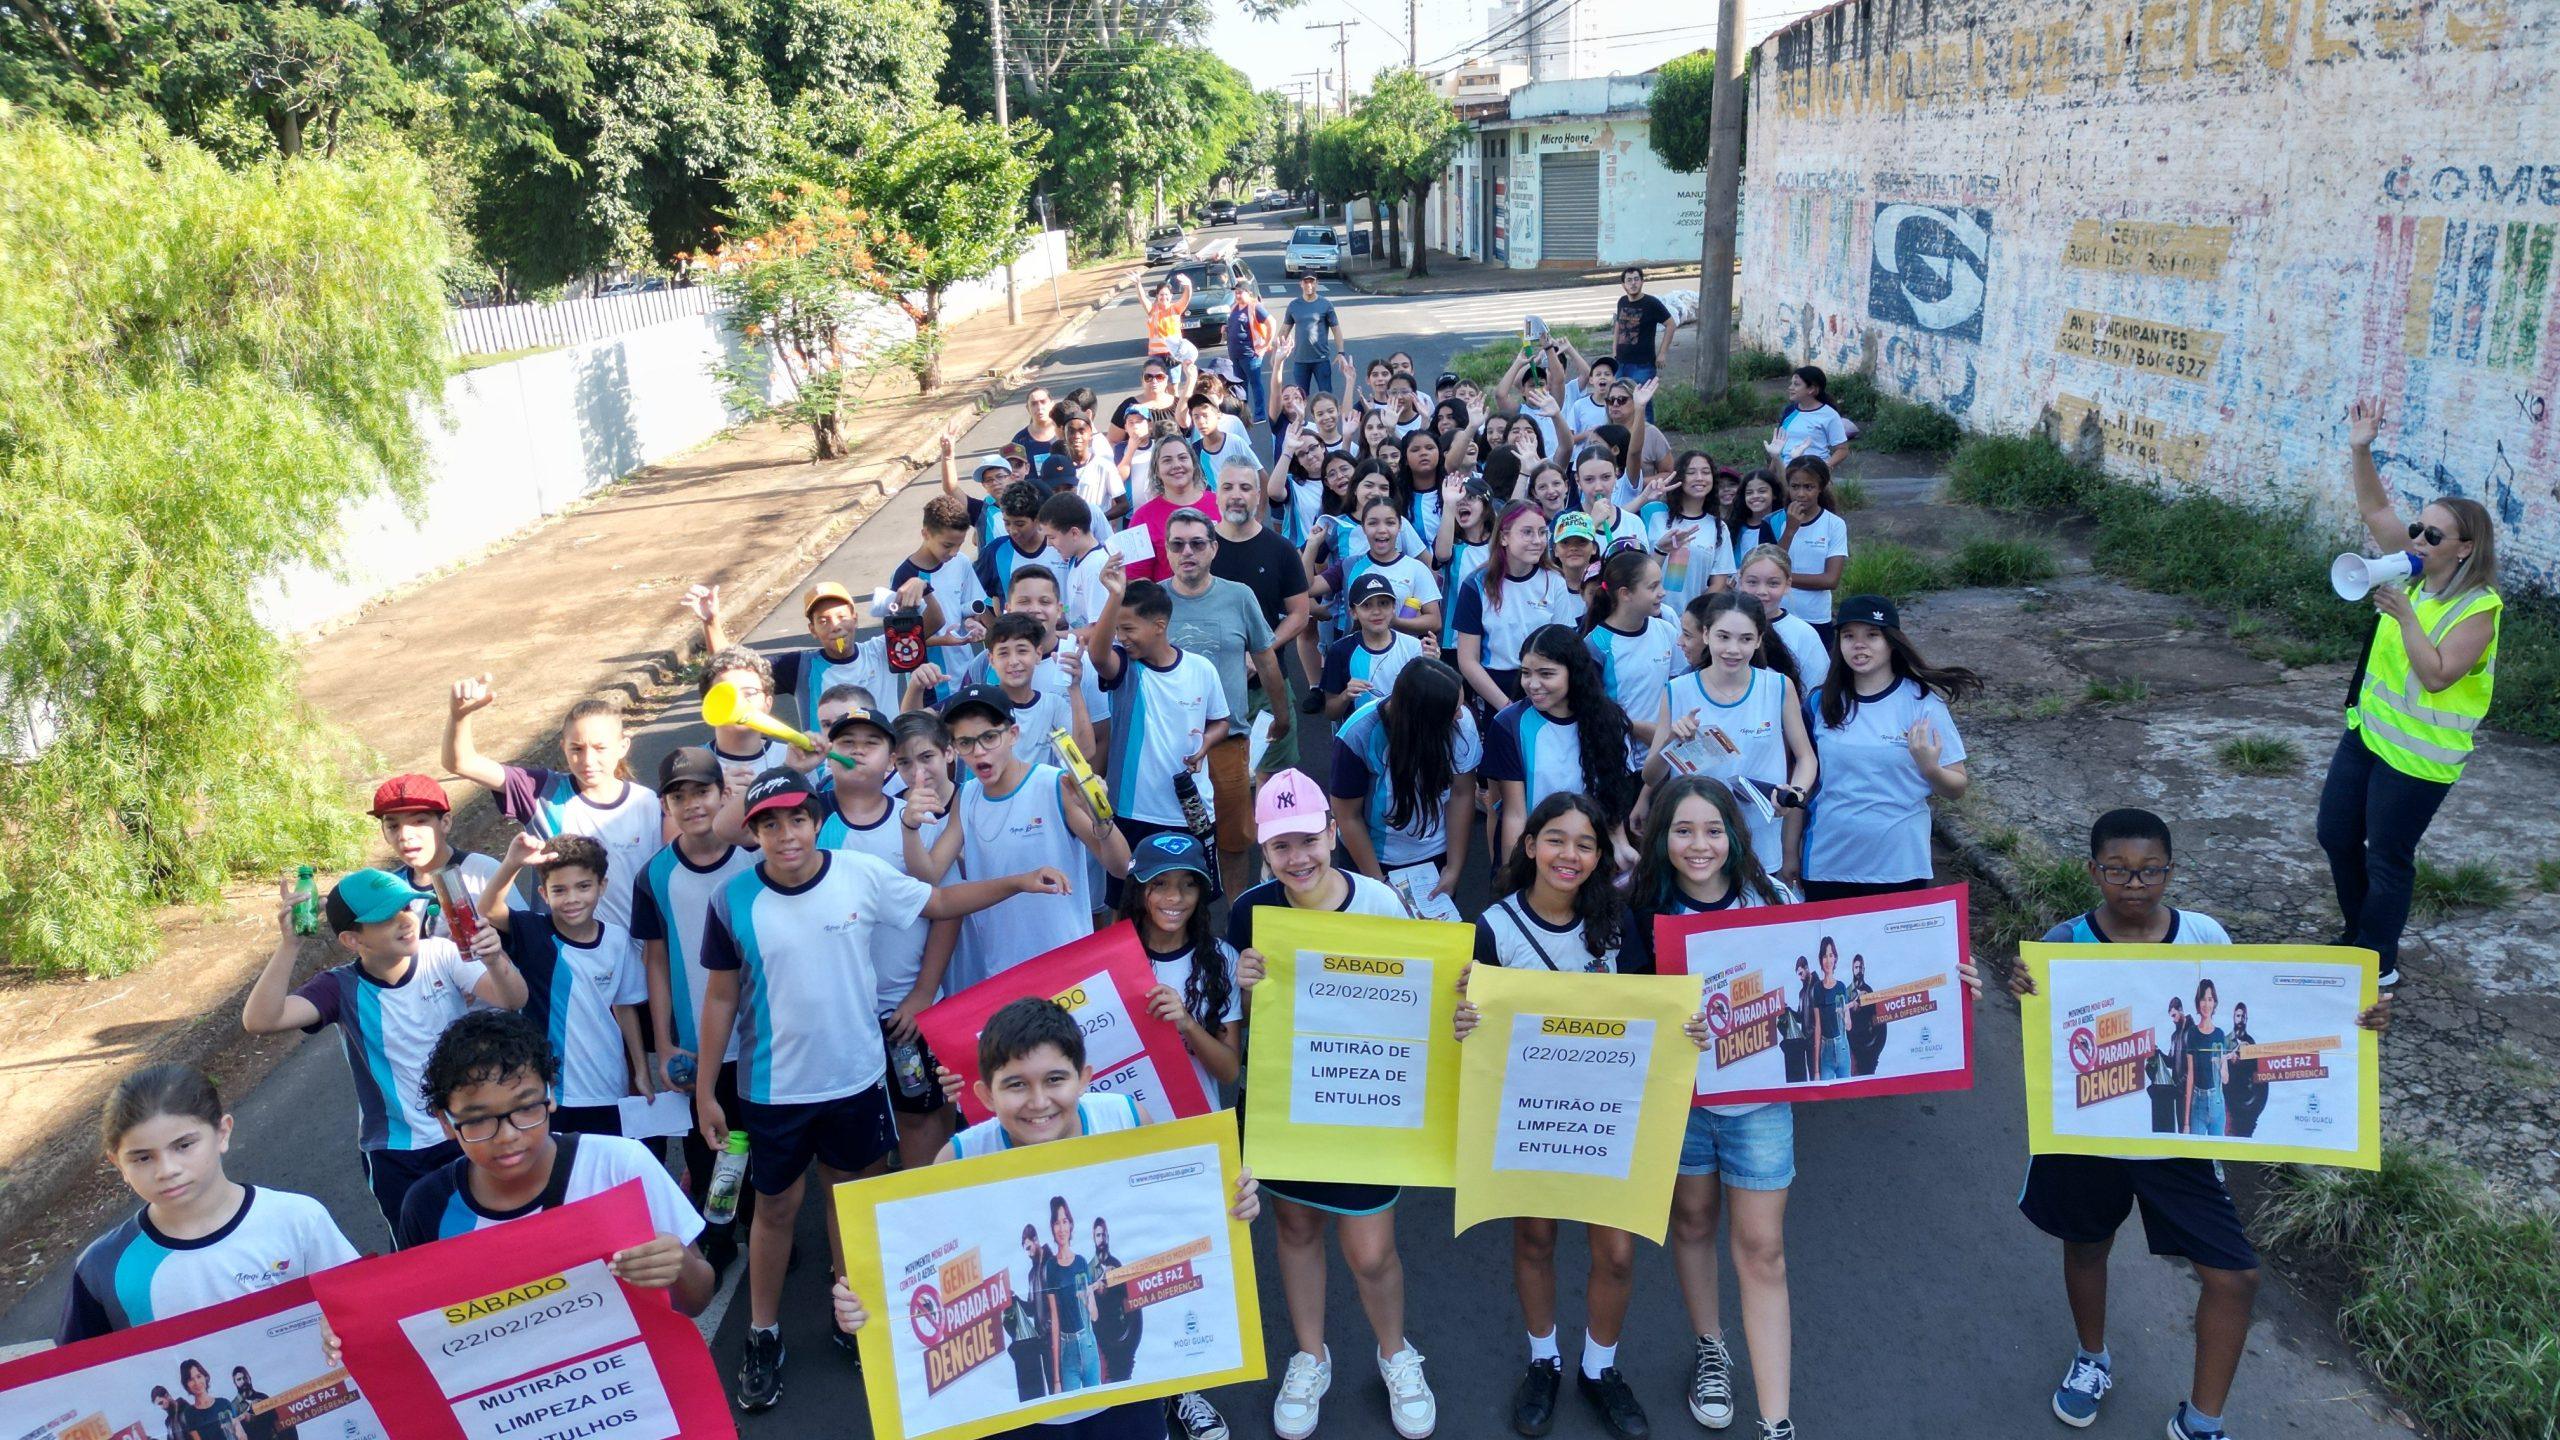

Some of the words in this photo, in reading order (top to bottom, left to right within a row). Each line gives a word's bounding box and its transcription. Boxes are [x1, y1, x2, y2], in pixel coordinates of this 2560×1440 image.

[1540, 133, 1563, 144] Micro
[2090, 318, 2188, 350] BNDEIRANTES
[1277, 791, 1295, 809] NY
[1324, 956, 1404, 975] SÁBADO
[1309, 982, 1418, 1006] (22/02/2025)
[1732, 976, 1761, 1000] GENTE
[1733, 1004, 1768, 1027] PARADA
[1769, 992, 1782, 1016] DÁ
[1885, 996, 1906, 1012] VOCÊ
[1907, 993, 1922, 1007] FAZ
[1542, 1017, 1626, 1036] SÁBADO
[2099, 1017, 2129, 1040] GENTE
[1310, 1040, 1384, 1056] MUTIRÃO
[1389, 1046, 1410, 1058] DE
[1720, 1020, 1770, 1065] DENGUE
[2099, 1043, 2135, 1066] PARADA
[2137, 1028, 2152, 1058] DÁ
[1522, 1046, 1637, 1067] (22/02/2025)
[2267, 1056, 2292, 1070] VOCÊ
[2294, 1055, 2311, 1067] FAZ
[1115, 1066, 1138, 1084] DE
[1312, 1066, 1380, 1081] LIMPEZA
[1385, 1070, 1407, 1082] DE
[2081, 1062, 2137, 1103] DENGUE
[2257, 1072, 2276, 1082] TODA
[2285, 1067, 2326, 1080] DIFERENÇA!
[1315, 1091, 1401, 1106] ENTULHOS
[1518, 1097, 1595, 1112] MUTIRÃO
[1600, 1101, 1622, 1113] DE
[1517, 1120, 1588, 1134] LIMPEZA
[1594, 1123, 1616, 1135] DE
[1518, 1141, 1608, 1157] ENTULHOS
[942, 1255, 979, 1294] GENTE
[1137, 1271, 1164, 1292] VOCÊ
[1165, 1266, 1184, 1284] FAZ
[446, 1277, 567, 1325] SÁBADO
[946, 1293, 990, 1332] PARADA
[991, 1278, 1008, 1310] DÁ
[1128, 1295, 1149, 1309] TODA
[1150, 1292, 1156, 1301] A
[1157, 1279, 1201, 1300] DIFERENÇA!
[442, 1291, 604, 1357] (22/02/2025)
[928, 1318, 996, 1389] DENGUE
[1174, 1339, 1191, 1348] MOGI
[478, 1366, 587, 1411] MUTIRÃO
[593, 1354, 626, 1374] DE
[281, 1414, 303, 1428] TODA
[311, 1392, 357, 1416] DIFERENÇA!
[288, 1394, 317, 1413] VOCÊ
[317, 1387, 338, 1402] FAZ
[495, 1394, 597, 1434] LIMPEZA
[601, 1381, 634, 1401] DE
[538, 1409, 638, 1440] TULHOS
